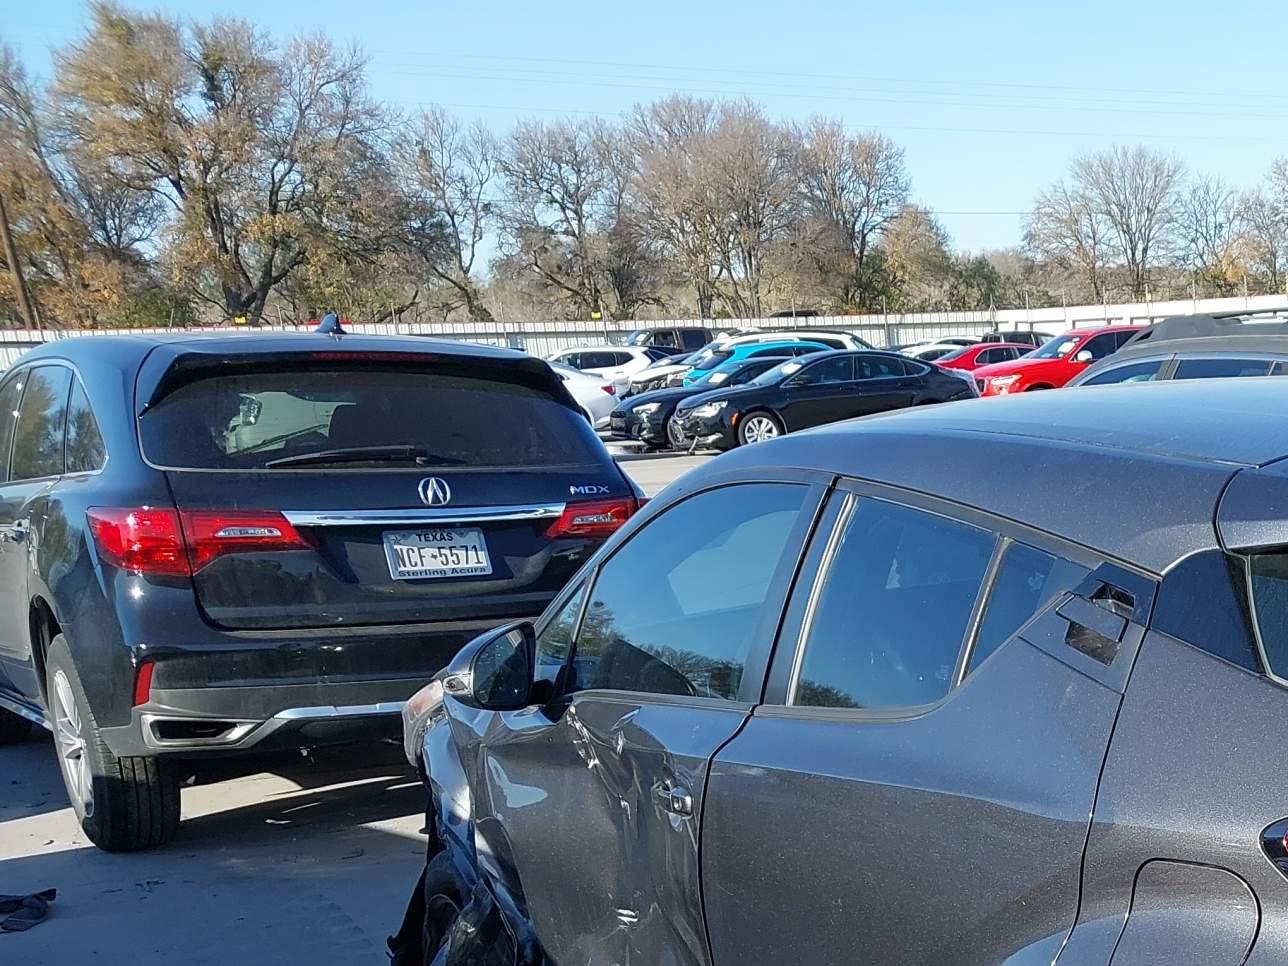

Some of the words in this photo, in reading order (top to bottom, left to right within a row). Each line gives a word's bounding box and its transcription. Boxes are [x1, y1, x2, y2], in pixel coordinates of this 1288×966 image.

[569, 485, 610, 495] MDX
[416, 532, 454, 543] TEXAS
[398, 569, 447, 578] Sterling
[450, 567, 486, 576] Acura
